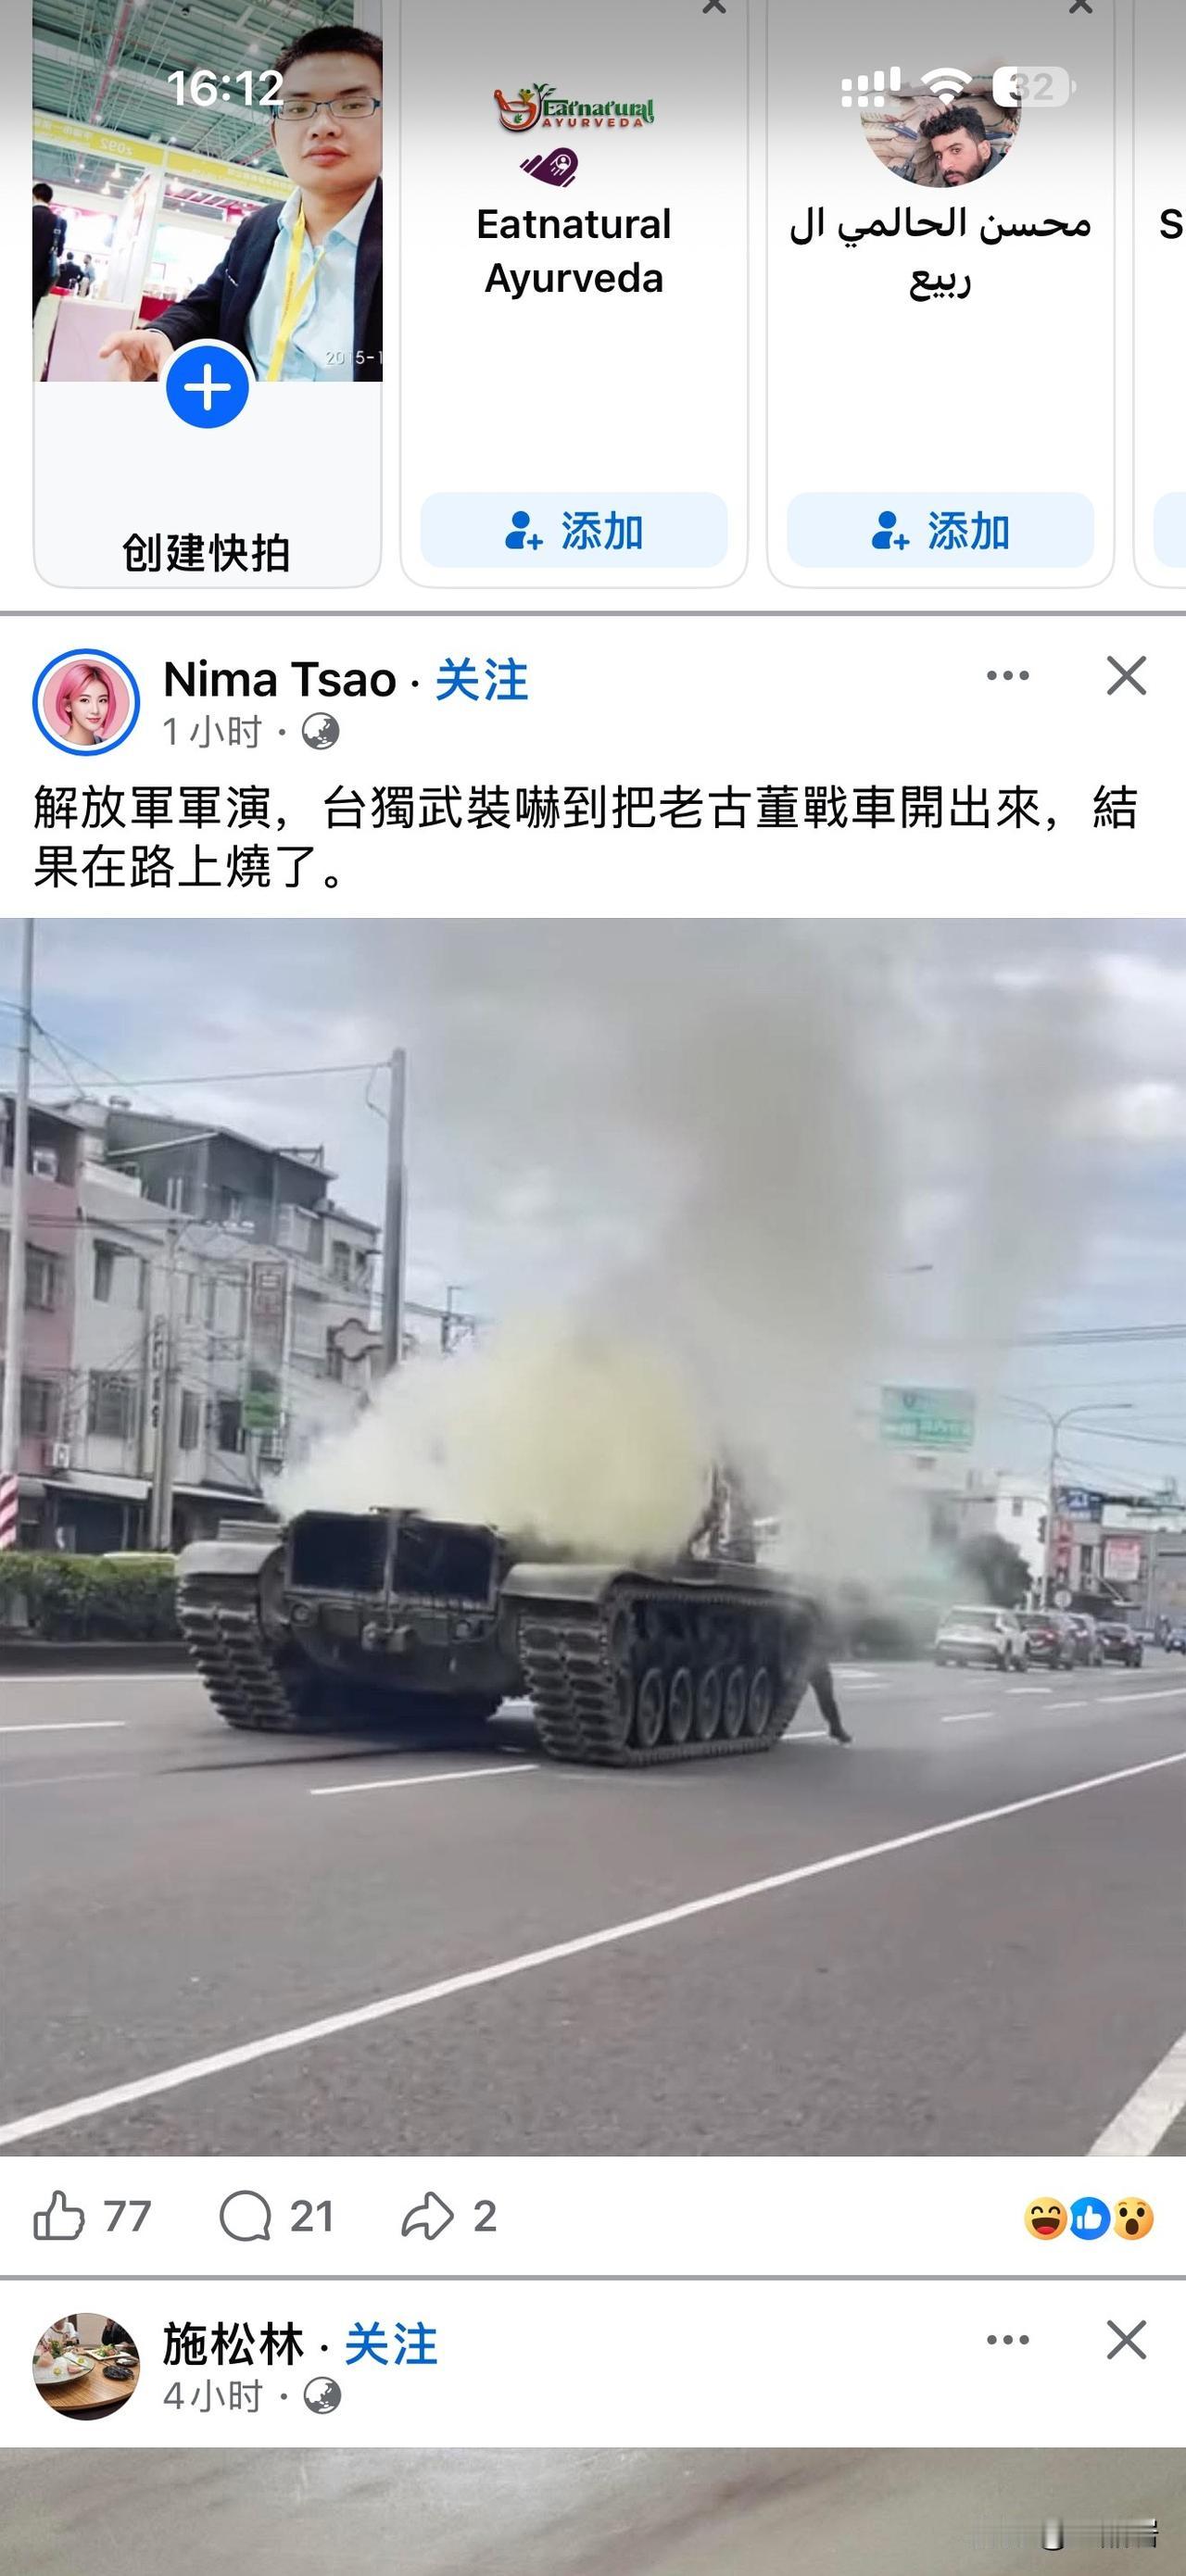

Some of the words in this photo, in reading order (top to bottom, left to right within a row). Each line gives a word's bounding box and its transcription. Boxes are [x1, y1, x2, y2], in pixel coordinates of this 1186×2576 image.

[168, 69, 284, 107] 16:12
[1009, 73, 1054, 100] 32
[542, 118, 643, 127] AYURVEDA
[479, 207, 671, 240] Eatnatural
[790, 206, 826, 245] ال
[838, 206, 967, 248] الحالمي
[979, 214, 1092, 245] محسن
[1160, 208, 1183, 239] S
[485, 261, 662, 301] Ayurveda
[910, 270, 971, 303] ربيع
[562, 510, 642, 550] 添加
[928, 510, 1009, 550] 添加
[122, 533, 289, 572] 创建快拍
[166, 659, 277, 697] Nima
[291, 661, 397, 697] Tsao
[436, 657, 529, 702] 关注
[34, 785, 1139, 832] 解放軍軍演，台獨武裝嚇到把老古董戰車開出來，結
[34, 843, 339, 889] 果在路上燒了。
[104, 2201, 152, 2232] 77
[291, 2201, 332, 2232] 21
[474, 2201, 497, 2232] 2
[163, 2322, 304, 2367] 施松林
[345, 2322, 438, 2367] 关注
[164, 2379, 263, 2413] 4小时
